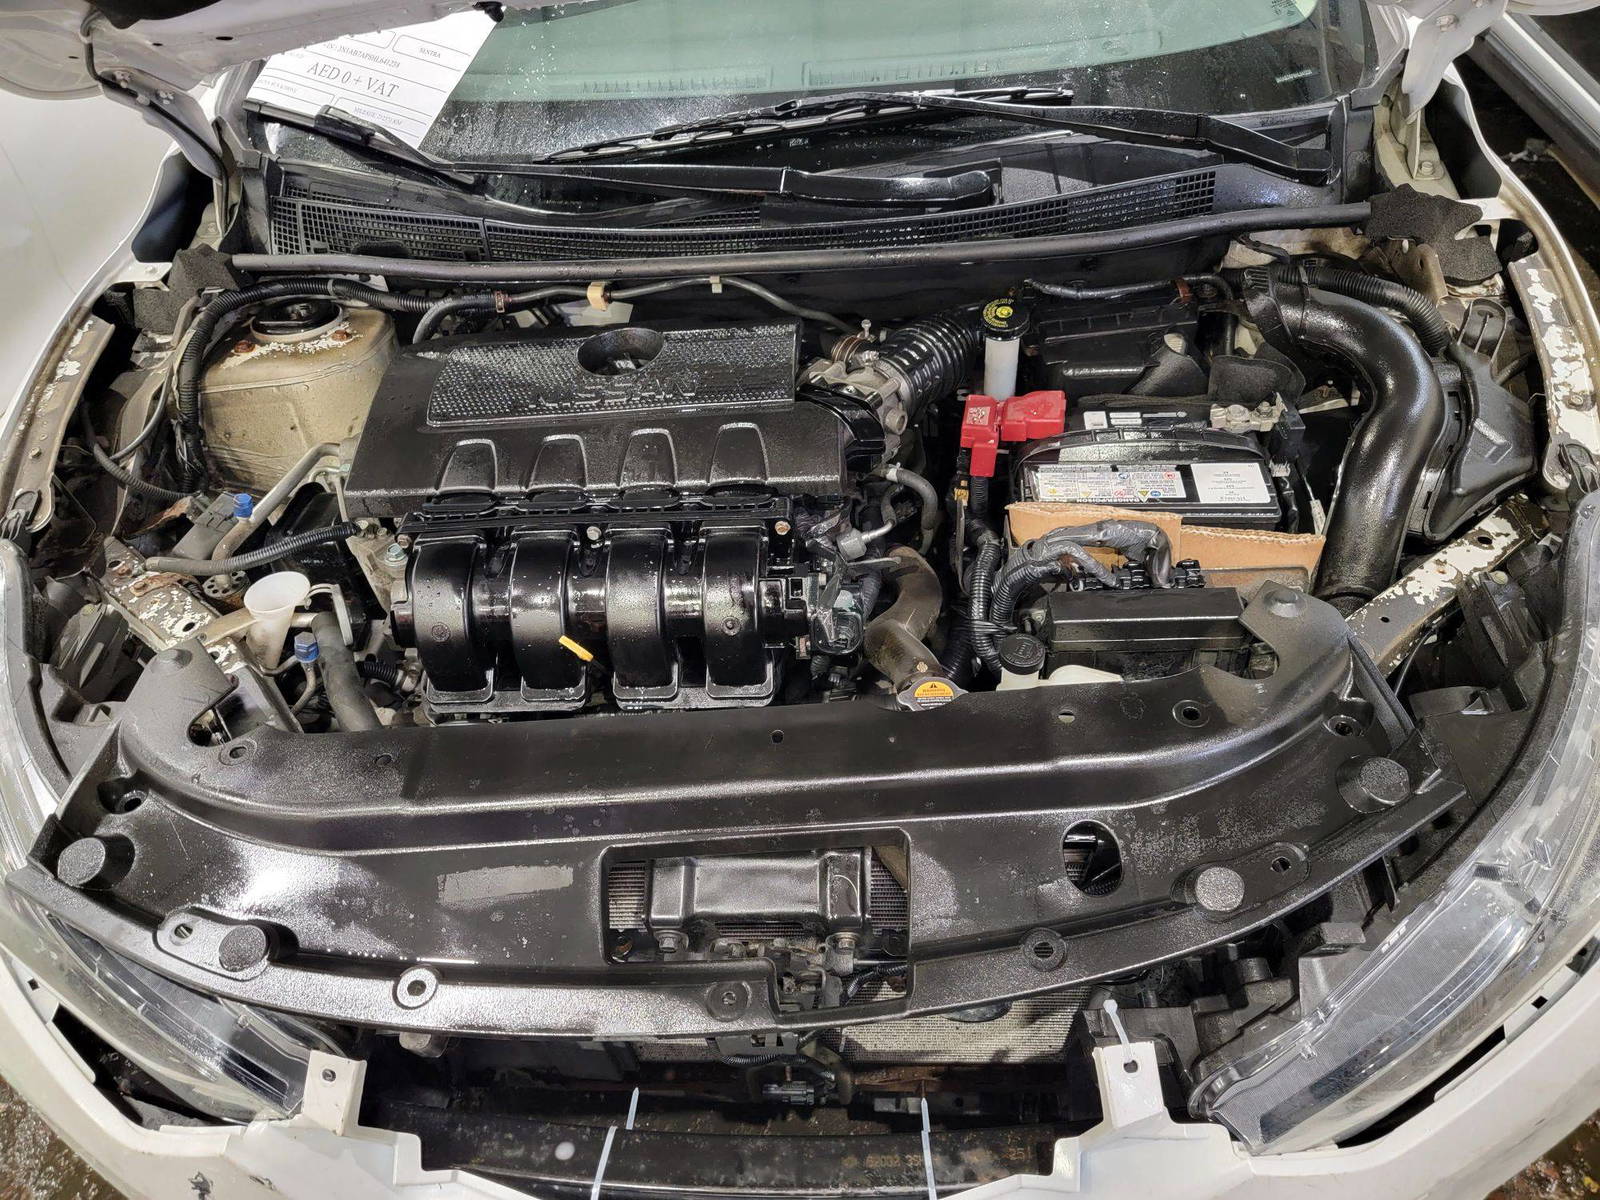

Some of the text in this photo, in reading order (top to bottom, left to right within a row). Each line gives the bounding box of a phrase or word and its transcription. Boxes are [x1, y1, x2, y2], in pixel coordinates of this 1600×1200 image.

[307, 62, 400, 98] AED 0 + VAT
